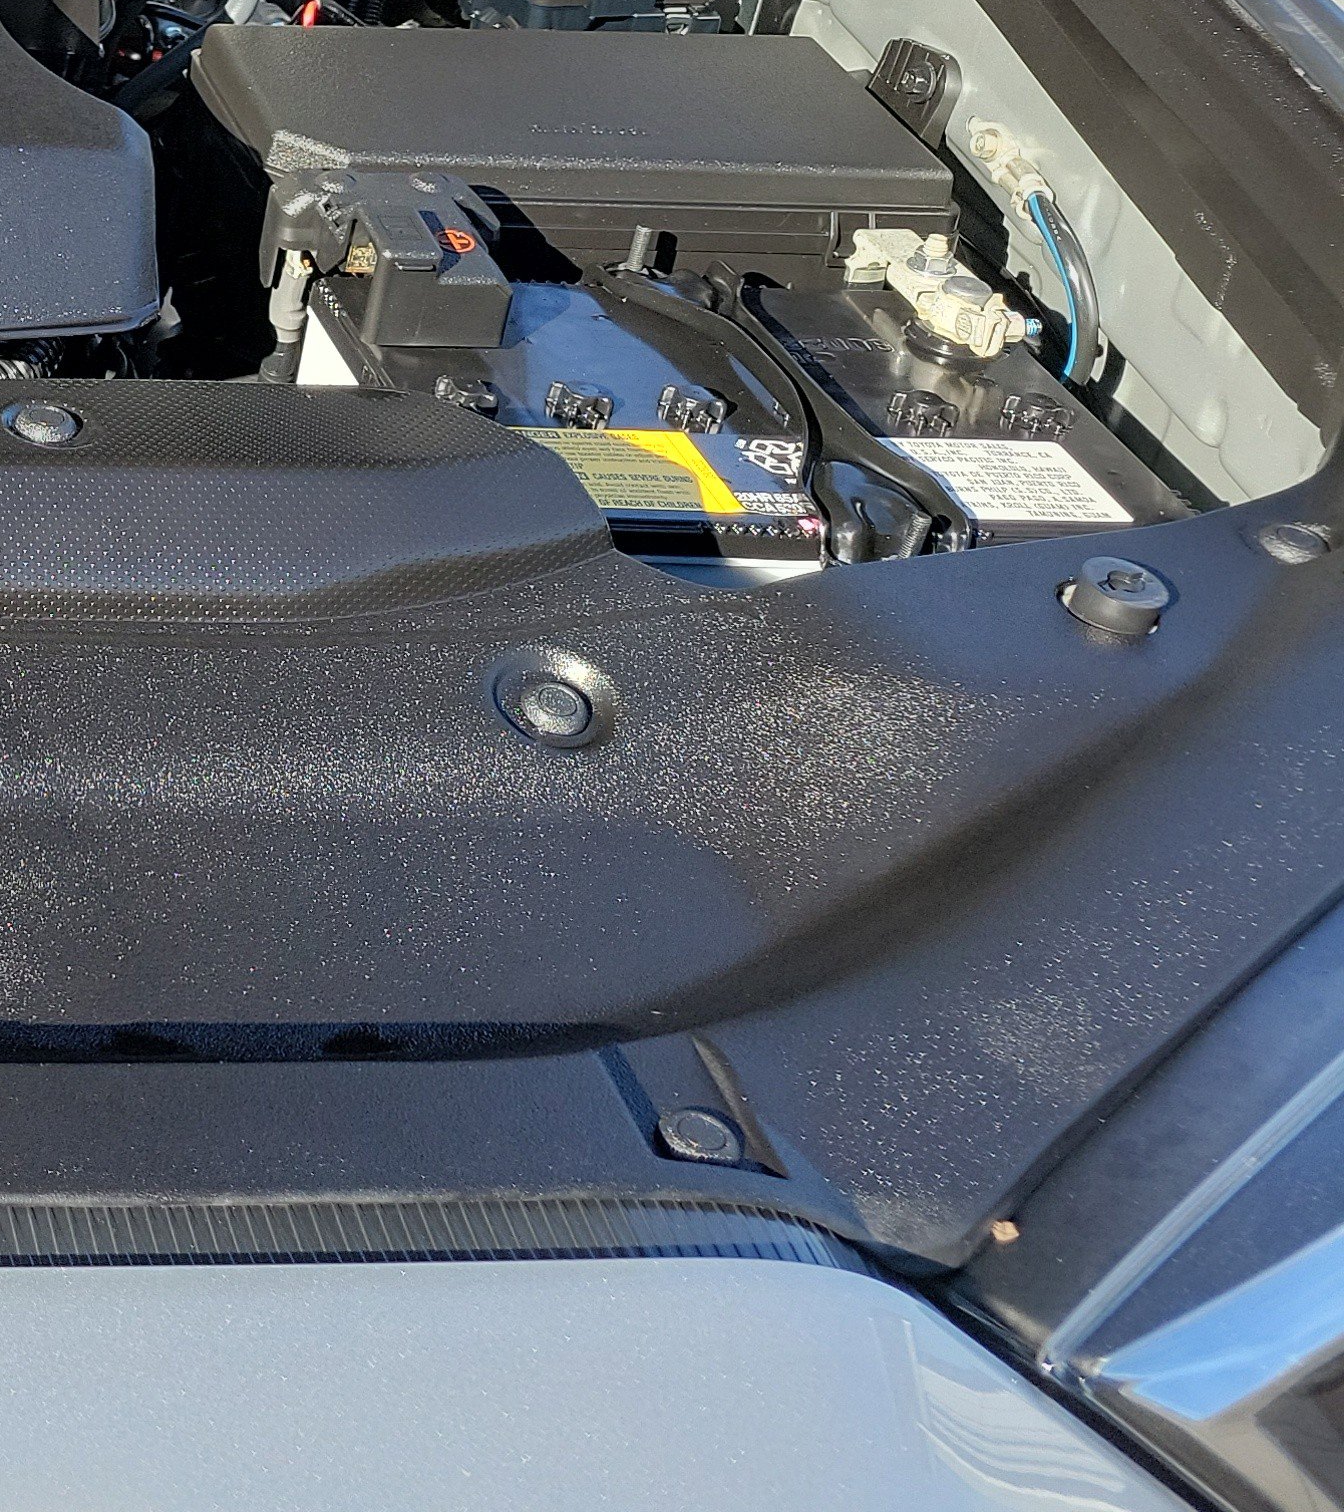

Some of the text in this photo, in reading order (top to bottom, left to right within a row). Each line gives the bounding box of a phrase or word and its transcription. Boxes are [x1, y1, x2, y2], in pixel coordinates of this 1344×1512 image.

[907, 441, 942, 449] TOYOTA
[592, 473, 628, 481] CAUSES
[628, 474, 662, 482] SEVERE
[657, 500, 702, 508] CHILDREN
[740, 501, 778, 513] CCA
